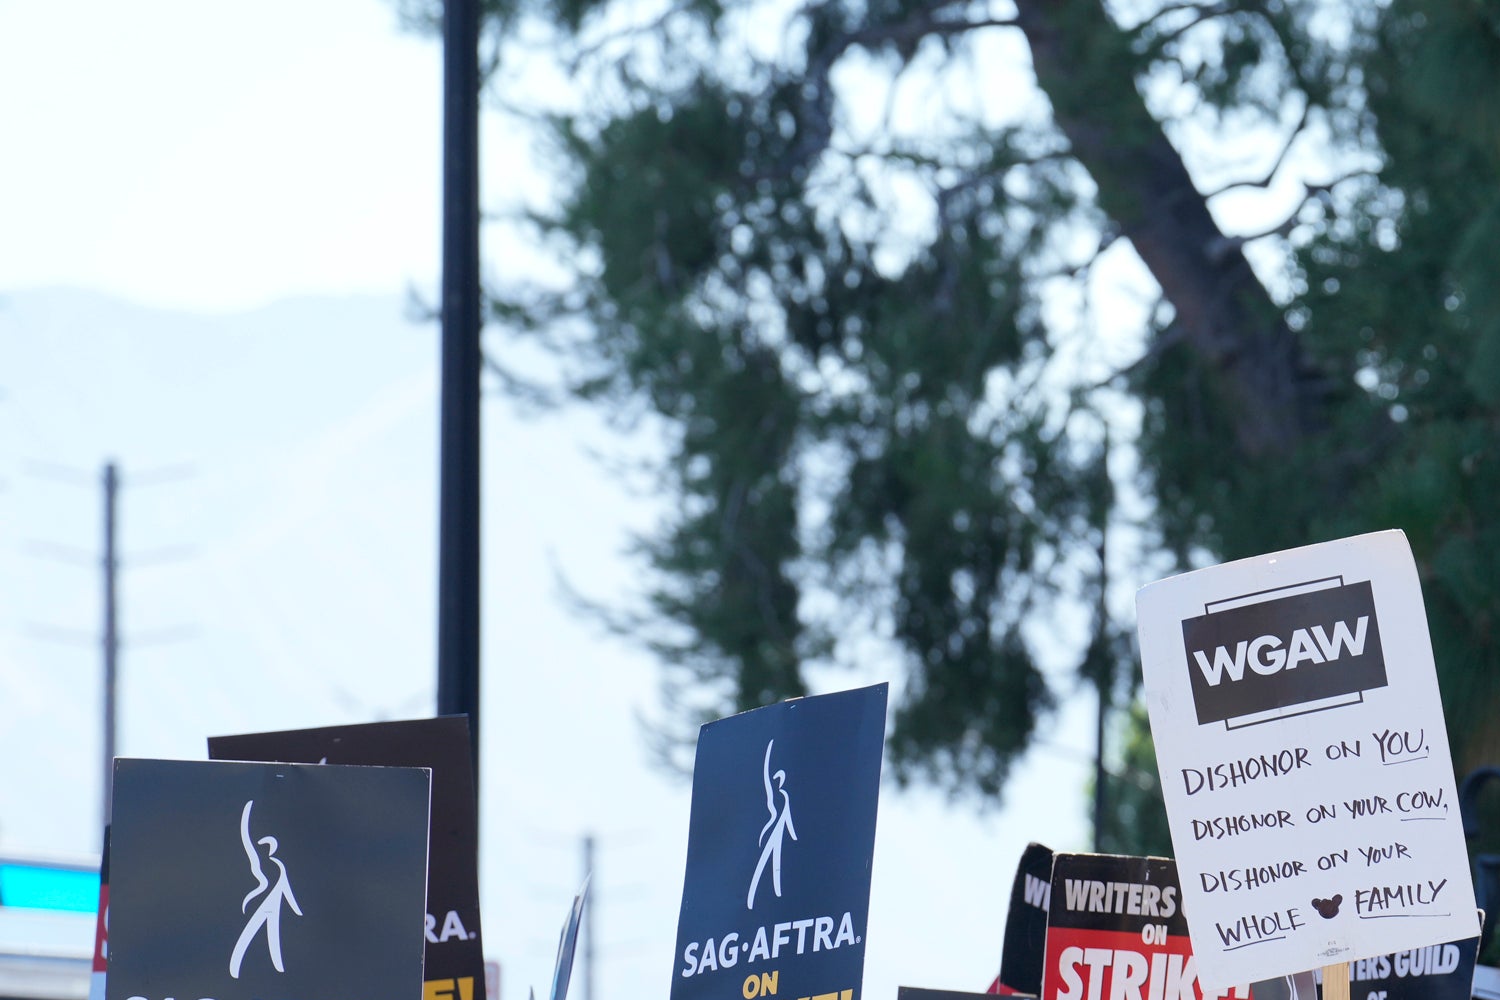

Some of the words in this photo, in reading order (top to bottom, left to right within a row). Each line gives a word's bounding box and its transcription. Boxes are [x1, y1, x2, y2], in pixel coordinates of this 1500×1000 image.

[1193, 615, 1369, 687] WGAW
[1181, 746, 1312, 796] DISHONOR
[1325, 740, 1361, 761] ON
[1191, 809, 1295, 841] DISHONOR
[1306, 804, 1337, 824] ON
[1343, 795, 1393, 820] YOUR
[1200, 859, 1308, 893] DISHONOR
[1317, 848, 1349, 872] ON
[1358, 842, 1413, 866] YOUR
[1065, 878, 1177, 918] WRITERS
[1215, 908, 1307, 947] WHOLE
[1354, 878, 1448, 915] FAMILY
[1141, 924, 1168, 947] ON
[1394, 944, 1461, 978] GUILD
[742, 970, 779, 1000] ON
